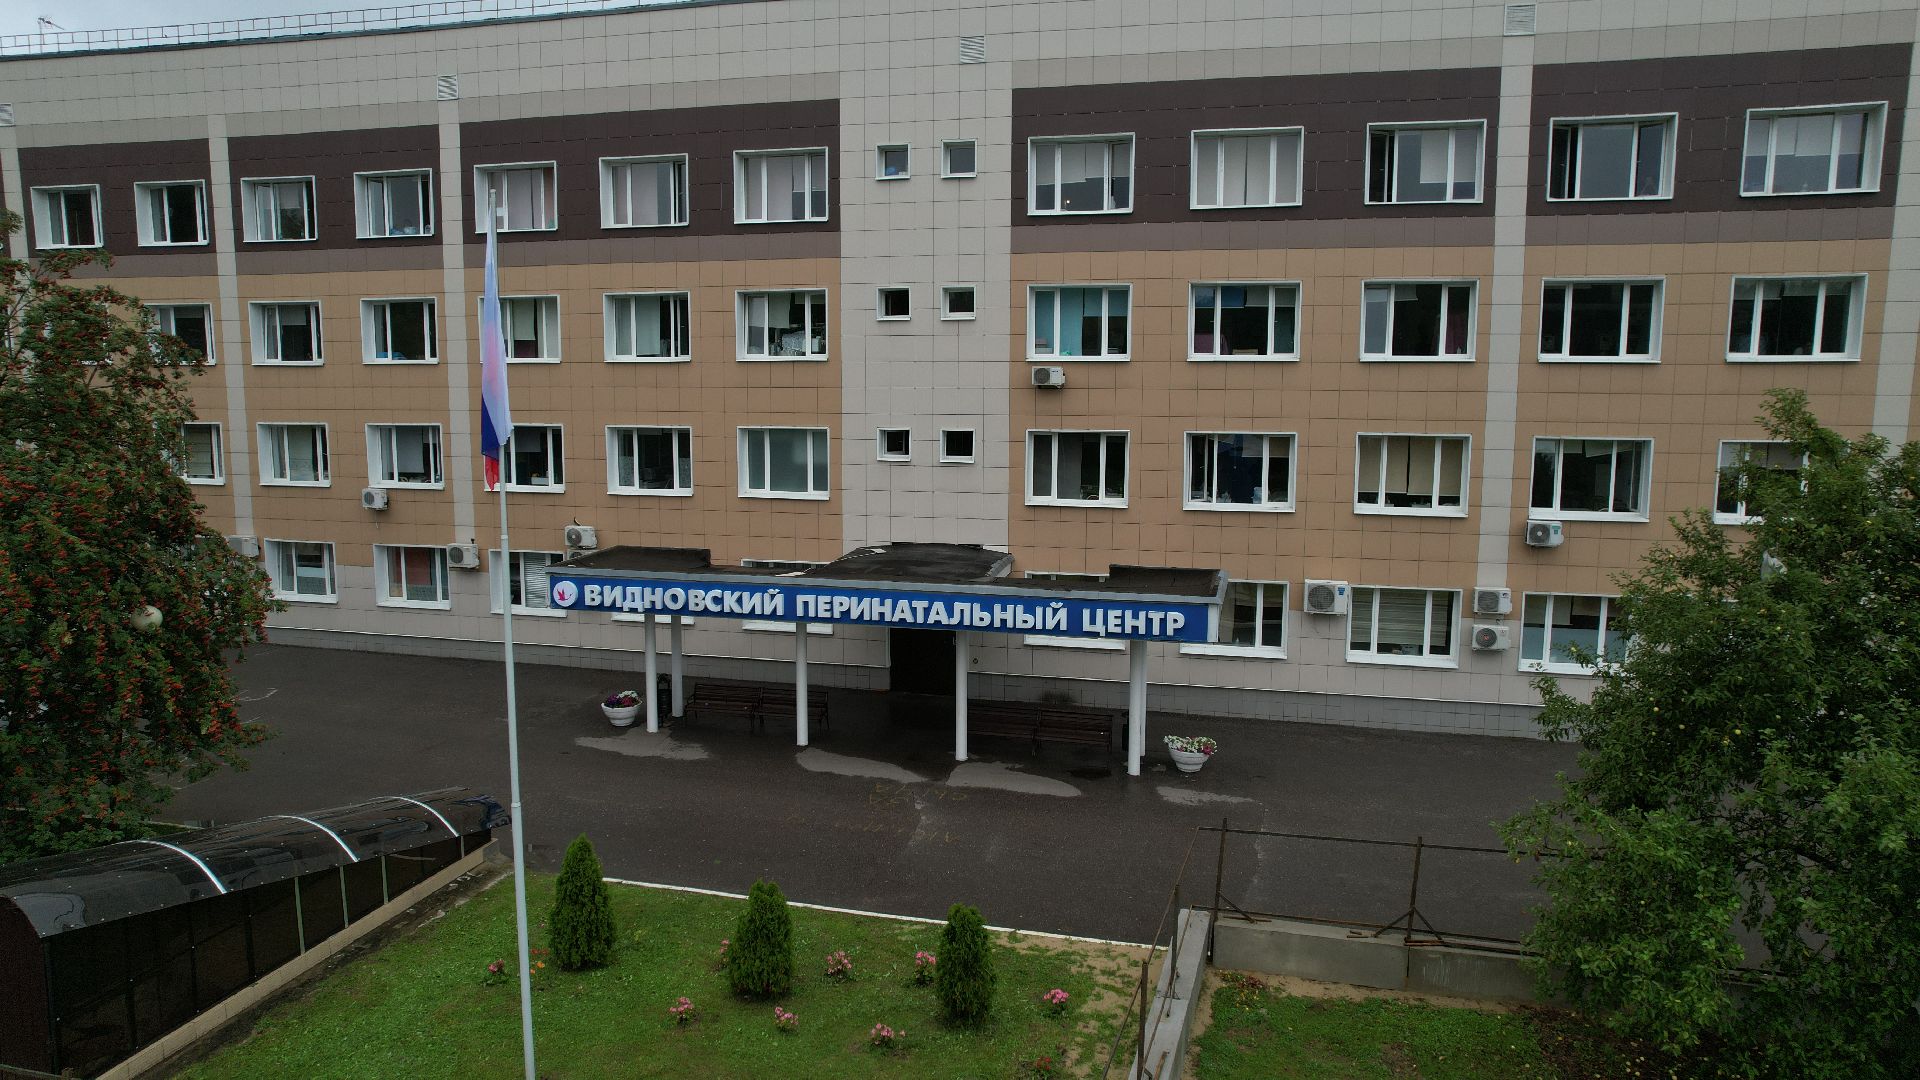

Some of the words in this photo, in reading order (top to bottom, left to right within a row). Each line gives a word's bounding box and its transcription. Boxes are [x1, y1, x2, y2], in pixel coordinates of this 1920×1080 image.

[583, 584, 785, 616] ВИДНОВСКИЙ
[796, 594, 1068, 631] ПЕРИНАТАЛЬНЫЙ
[1082, 607, 1186, 637] ЦЕНТР
